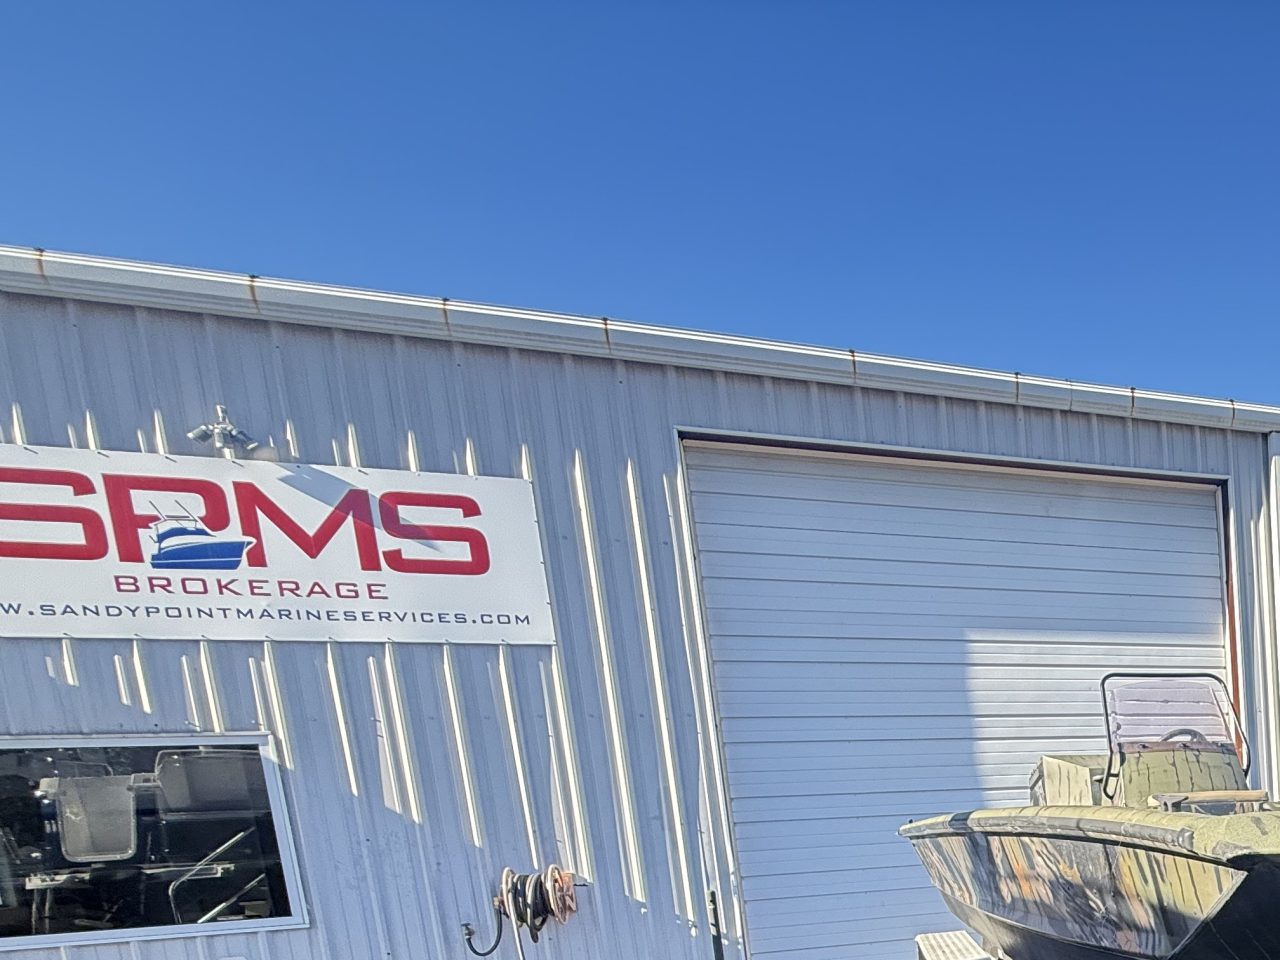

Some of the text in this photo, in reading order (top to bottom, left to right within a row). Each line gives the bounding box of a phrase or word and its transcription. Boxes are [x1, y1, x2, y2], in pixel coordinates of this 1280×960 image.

[0, 467, 491, 576] SPMS
[114, 575, 389, 600] BROKERAGE
[0, 602, 531, 626] W.SANDYPOINTMARINESERVICES.COM
